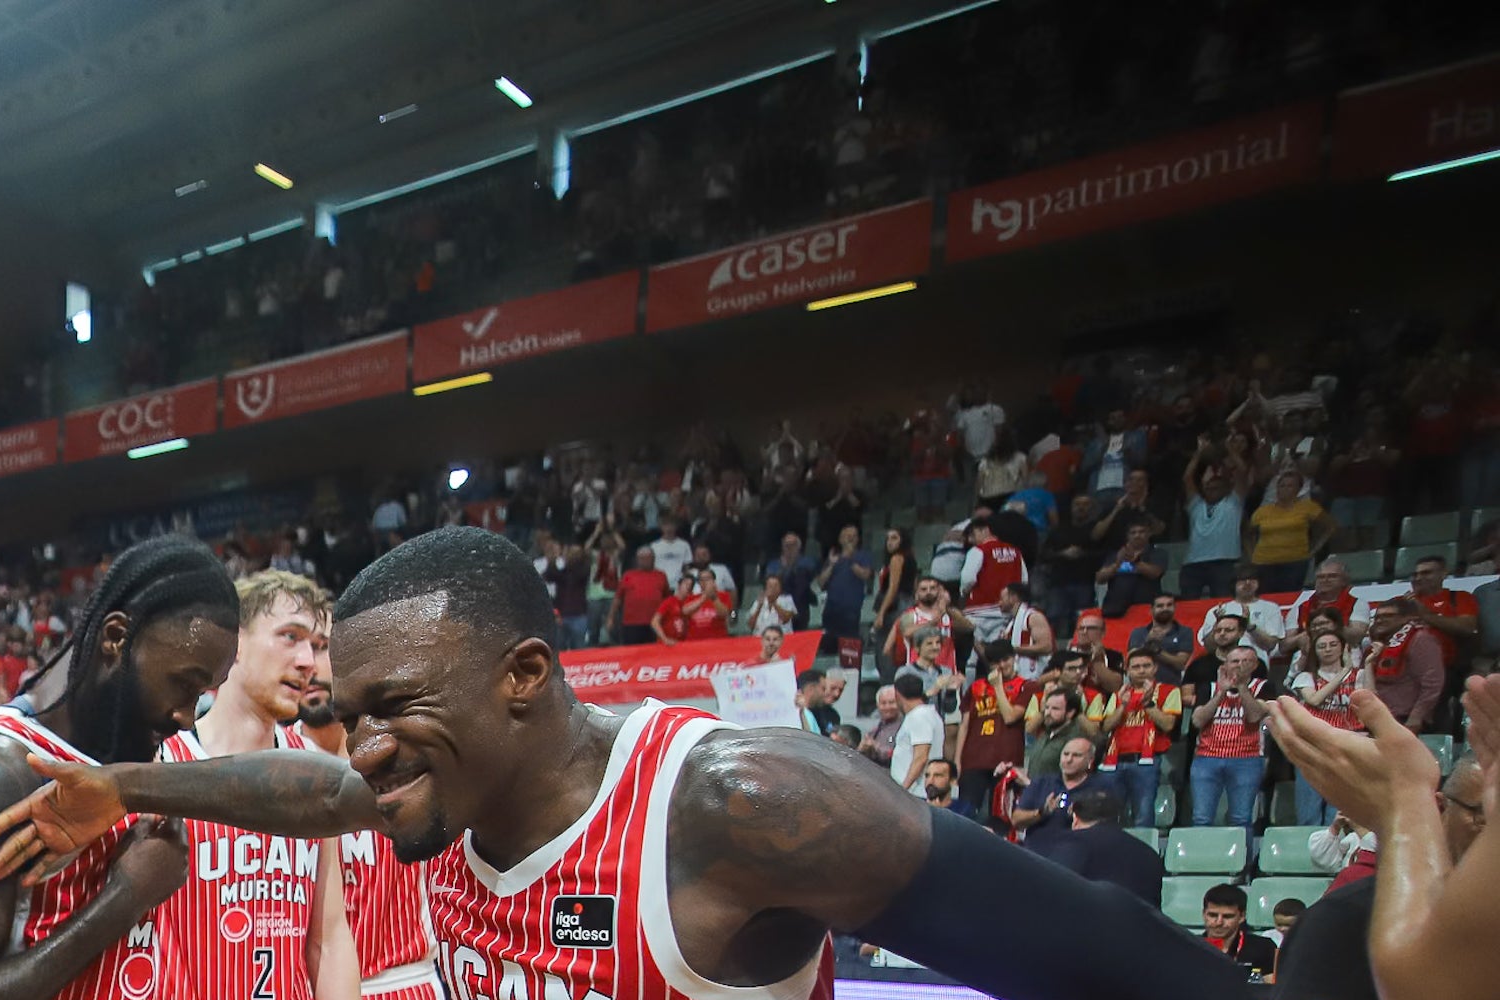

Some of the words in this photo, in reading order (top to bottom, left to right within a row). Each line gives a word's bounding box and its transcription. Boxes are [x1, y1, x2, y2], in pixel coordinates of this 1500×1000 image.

[736, 224, 858, 280] caser
[706, 291, 768, 314] Grupo
[772, 269, 857, 299] Helvetia
[460, 334, 539, 365] Halcón
[637, 666, 673, 682] DE
[199, 834, 320, 883] UCAM
[220, 880, 307, 906] MURCIA
[556, 911, 580, 928] liga
[555, 926, 610, 942] endesa
